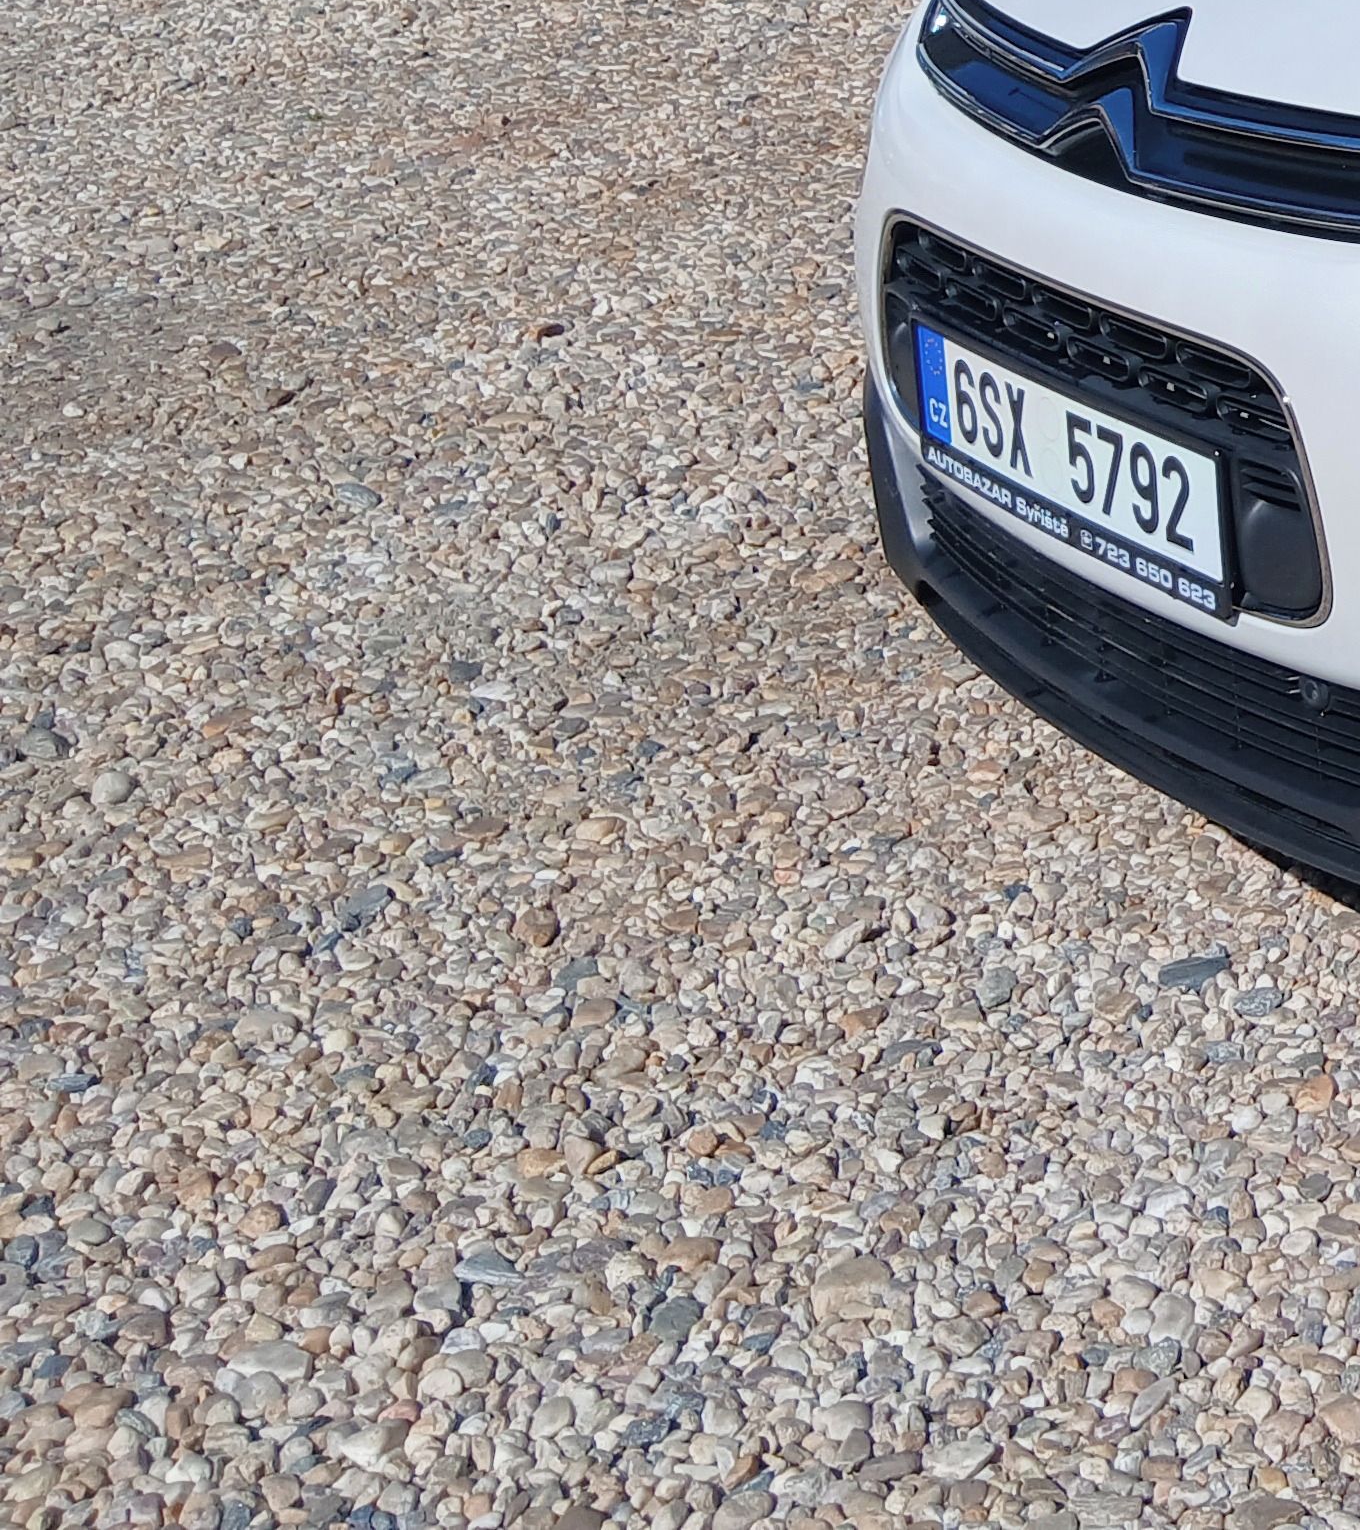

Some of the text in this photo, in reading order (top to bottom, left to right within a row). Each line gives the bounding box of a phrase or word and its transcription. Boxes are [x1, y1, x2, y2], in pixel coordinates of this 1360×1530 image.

[929, 397, 948, 429] CZ
[954, 359, 1195, 554] 6SX 5792
[928, 446, 1216, 611] AUTOBAZAR Syřiště 723 650 623
